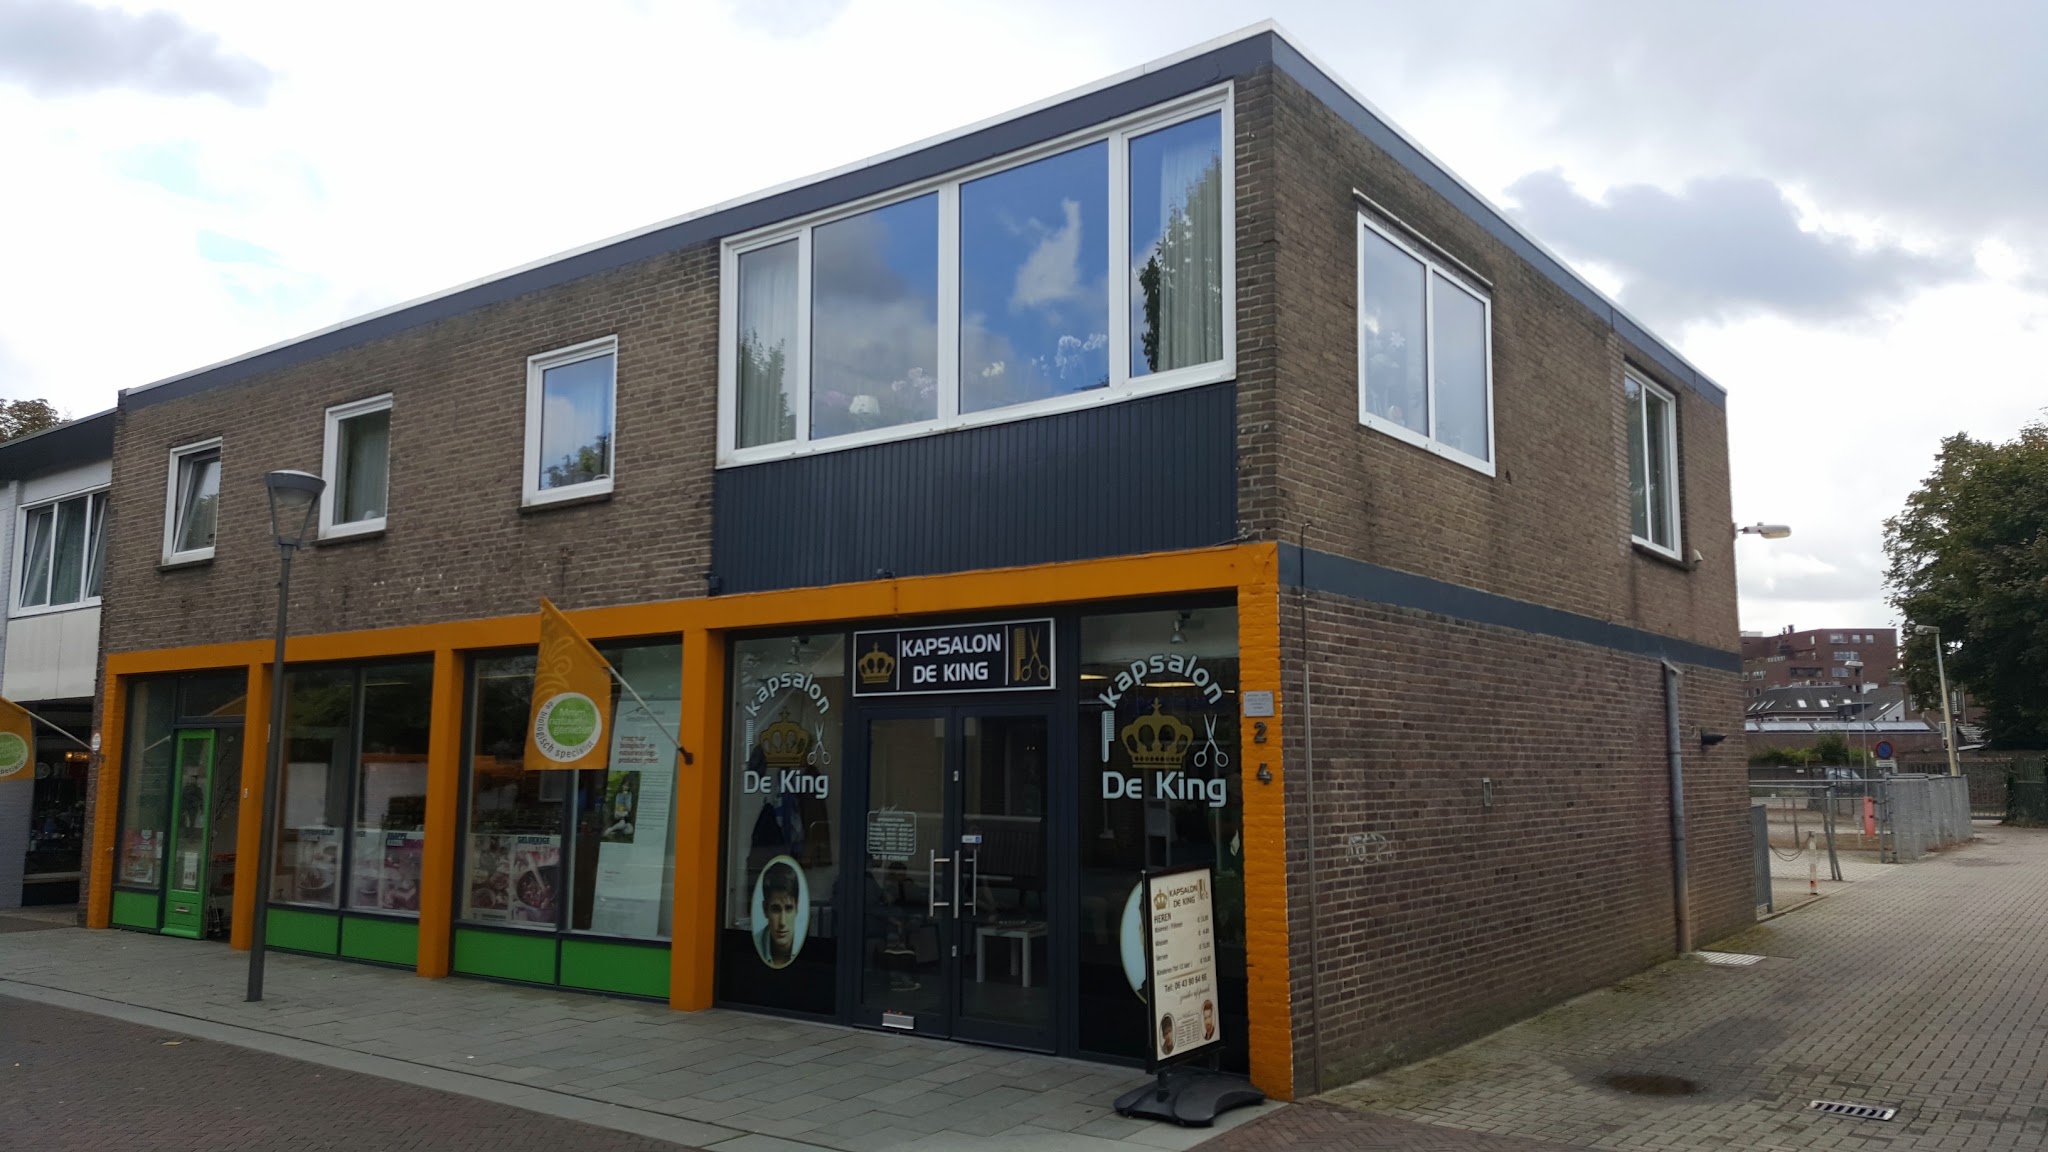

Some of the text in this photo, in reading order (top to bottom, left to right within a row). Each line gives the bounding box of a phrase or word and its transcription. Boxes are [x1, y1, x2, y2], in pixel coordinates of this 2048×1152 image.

[901, 633, 1001, 658] KAPSALON
[913, 662, 989, 684] DE KING
[1098, 653, 1224, 709] kapsalon
[745, 672, 831, 717] kapsalon
[1254, 721, 1268, 743] 2
[743, 770, 830, 800] De King
[1102, 771, 1227, 808] De King
[1169, 884, 1198, 897] KAPSALON
[1173, 896, 1196, 908] DE KING
